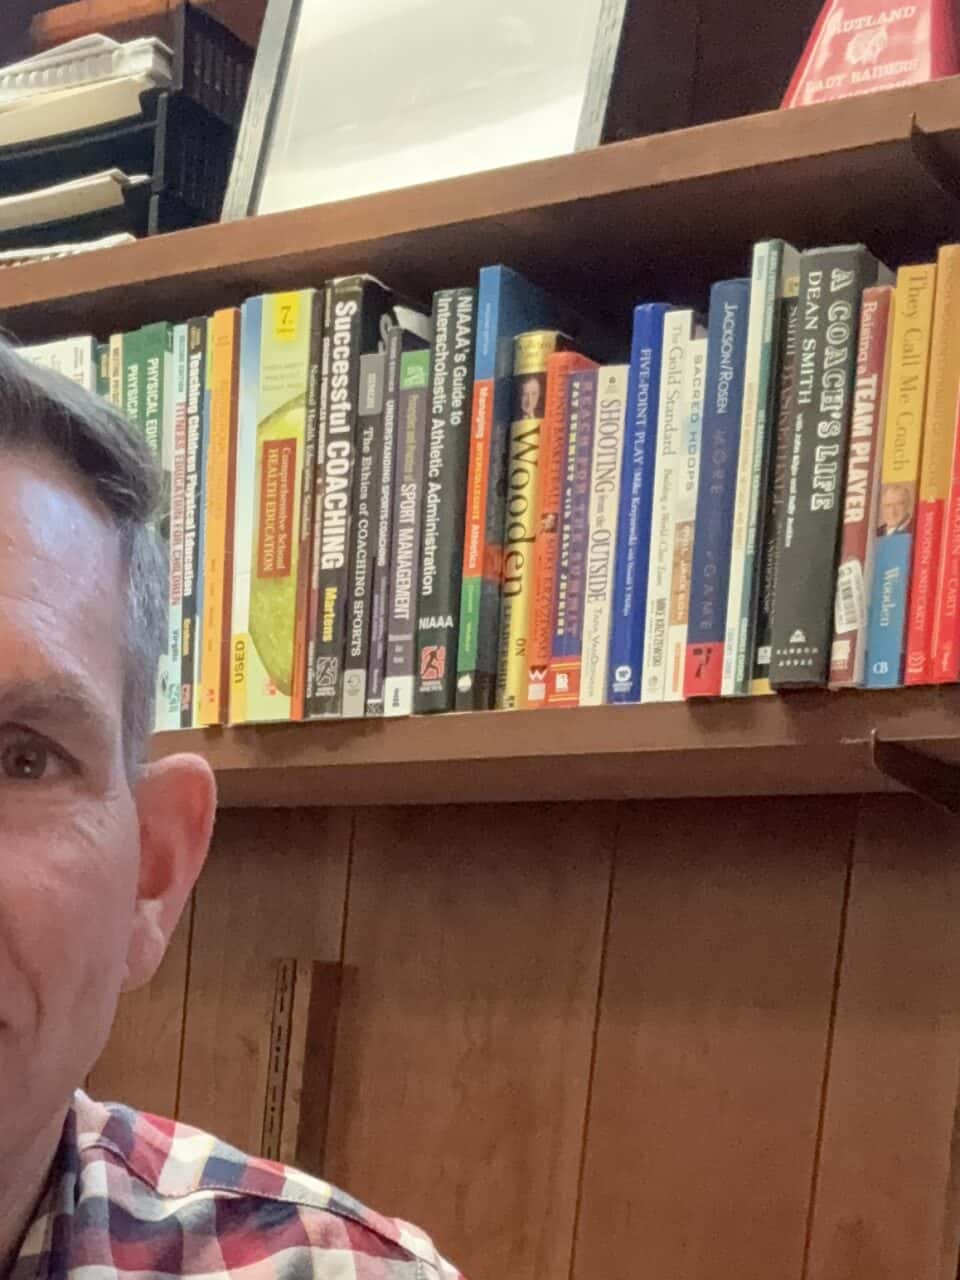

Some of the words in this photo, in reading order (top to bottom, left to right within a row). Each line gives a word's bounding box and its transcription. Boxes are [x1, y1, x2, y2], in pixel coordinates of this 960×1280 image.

[804, 270, 823, 331] DEAN
[830, 267, 856, 293] A
[902, 270, 928, 319] They
[431, 297, 454, 415] Interscholastic
[454, 295, 473, 363] NIAAA's
[671, 325, 683, 343] The
[857, 301, 878, 362] Raising
[901, 328, 923, 368] Call
[146, 358, 159, 417] PHYSICAL
[187, 352, 202, 414] Teaching
[329, 300, 358, 434] Successful
[451, 365, 468, 406] Guide
[635, 348, 652, 425] FIVE-POINT
[667, 345, 683, 386] Gold
[717, 303, 739, 415] JACKSON/ROSEN
[797, 338, 818, 405] SMITH
[817, 299, 853, 438] COACH'S
[450, 408, 465, 425] to
[474, 386, 489, 439] Managing
[571, 381, 581, 407] PAT
[579, 380, 594, 440] REACH
[689, 354, 704, 424] SACRED
[851, 374, 878, 438] TEAM
[899, 374, 920, 403] Me
[175, 402, 186, 450] FITNESS
[186, 415, 200, 473] Children
[362, 427, 374, 454] The
[381, 400, 396, 483] UNDERSTANDING
[428, 417, 447, 478] Athletic
[594, 399, 621, 493] SHOOTING
[633, 430, 647, 464] PLAY
[663, 388, 681, 456] Standard
[892, 410, 914, 473] Coach
[173, 455, 185, 520] EDUCATION
[266, 449, 280, 501] HEALTH
[278, 447, 292, 531] Comprehensive
[359, 456, 372, 500] Ethics
[576, 456, 590, 494] FOR
[631, 467, 643, 490] Mike
[686, 431, 701, 491] HOOPS
[810, 443, 840, 513] LIFE
[843, 442, 871, 524] PLAYER
[185, 474, 198, 530] Physical
[321, 441, 351, 570] COACHING
[358, 502, 369, 517] of
[379, 485, 390, 518] SPORTS
[400, 483, 416, 523] SPORT
[503, 424, 541, 599] Wooden
[563, 487, 573, 519] with
[172, 524, 183, 546] FOR
[263, 503, 278, 572] EDUCATION
[276, 533, 289, 569] School
[353, 519, 369, 598] COACHING
[377, 519, 388, 567] COACHING
[421, 482, 443, 596] Administration
[468, 523, 480, 569] Athletics
[561, 524, 572, 568] SALLY
[170, 549, 182, 606] CHILDREN
[183, 531, 196, 597] Education
[393, 526, 415, 621] MANAGEMENT
[588, 528, 612, 604] OUTSIDE
[322, 586, 338, 643] Martens
[418, 615, 454, 631] NIAAA
[699, 562, 718, 630] GAME
[880, 566, 900, 628] Wooden
[914, 595, 926, 631] CARTY
[946, 578, 959, 617] CARTY
[351, 600, 365, 657] SPORTS
[515, 637, 527, 657] ON
[234, 640, 246, 685] USED
